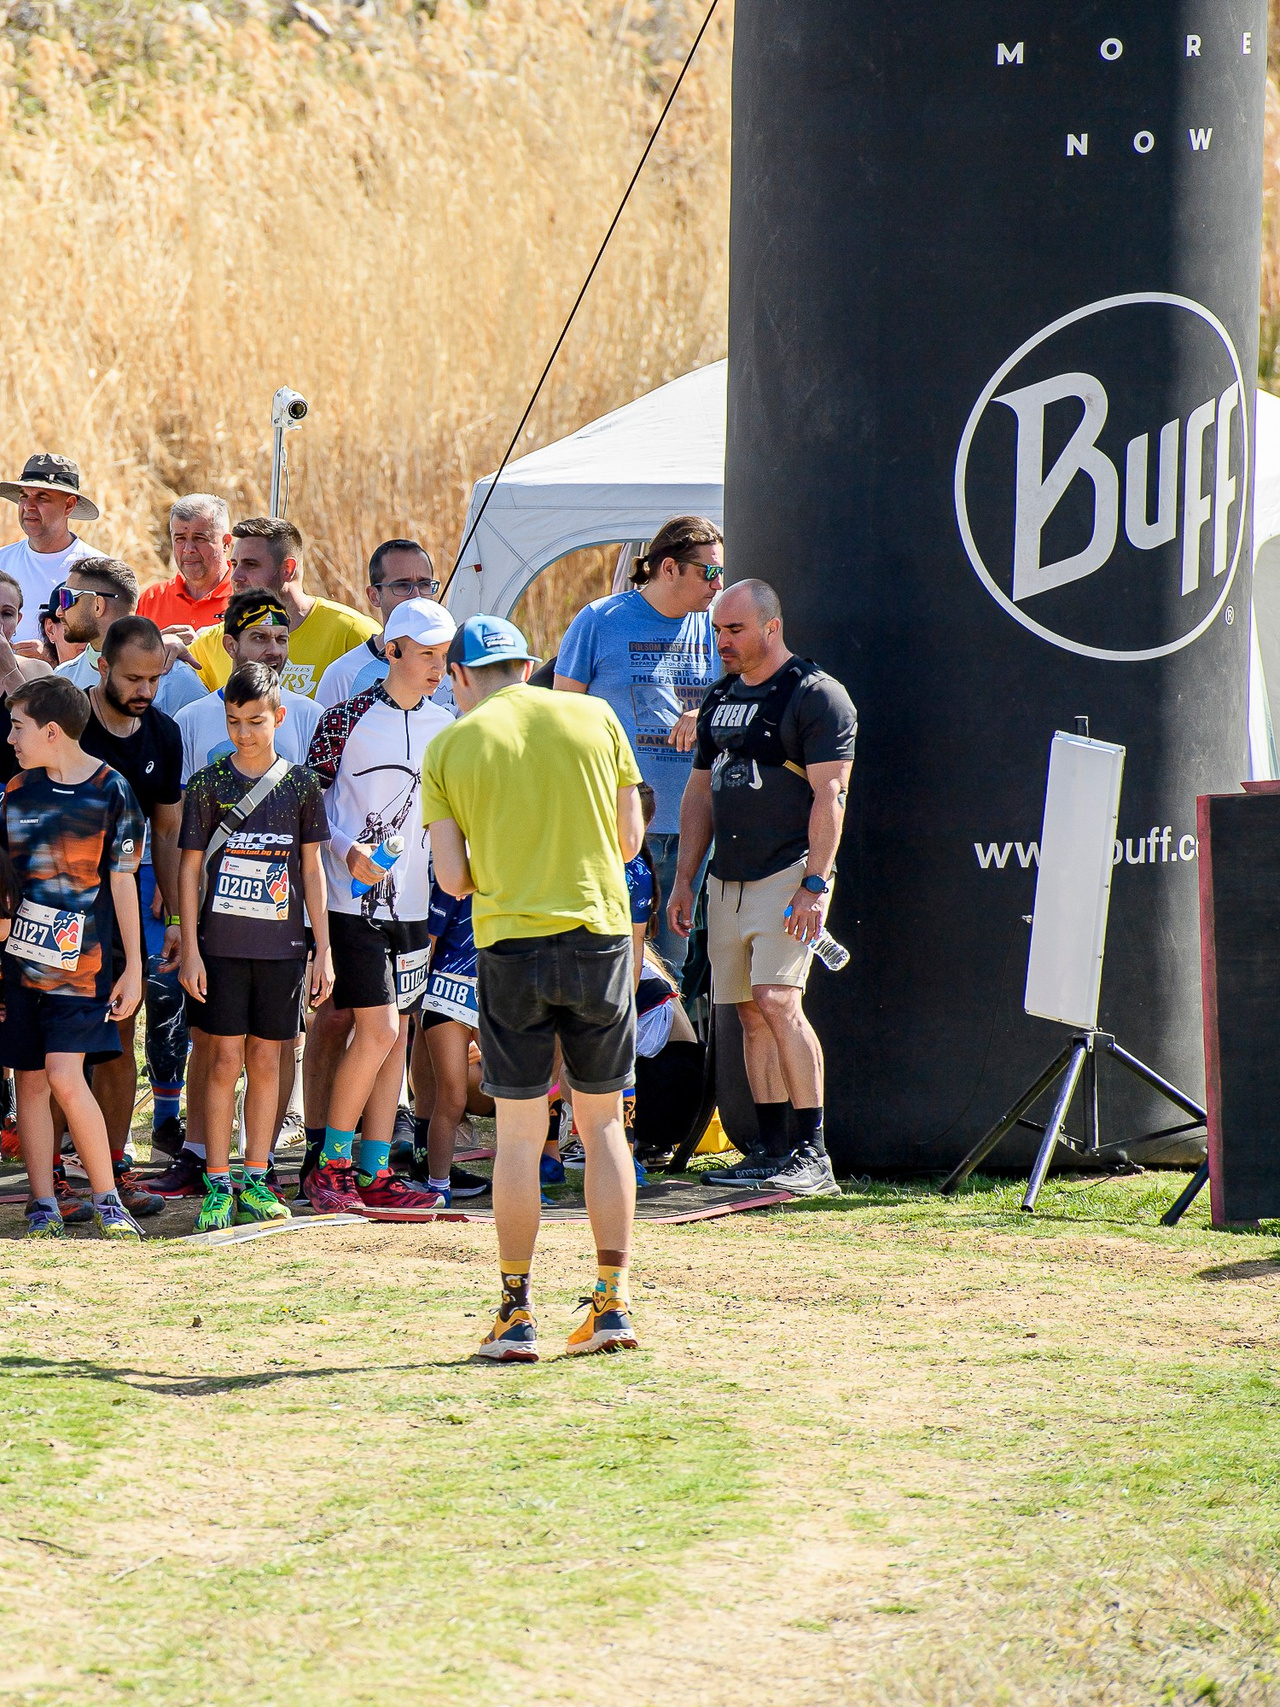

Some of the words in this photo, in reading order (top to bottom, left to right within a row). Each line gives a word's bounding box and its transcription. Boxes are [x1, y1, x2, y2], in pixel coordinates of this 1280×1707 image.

[996, 31, 1252, 65] MORE
[1066, 127, 1213, 156] NOW
[630, 643, 661, 652] FOLSOM
[631, 674, 655, 684] THE
[218, 875, 263, 900] 0203
[12, 917, 50, 946] 0127
[432, 976, 469, 1005] 0118
